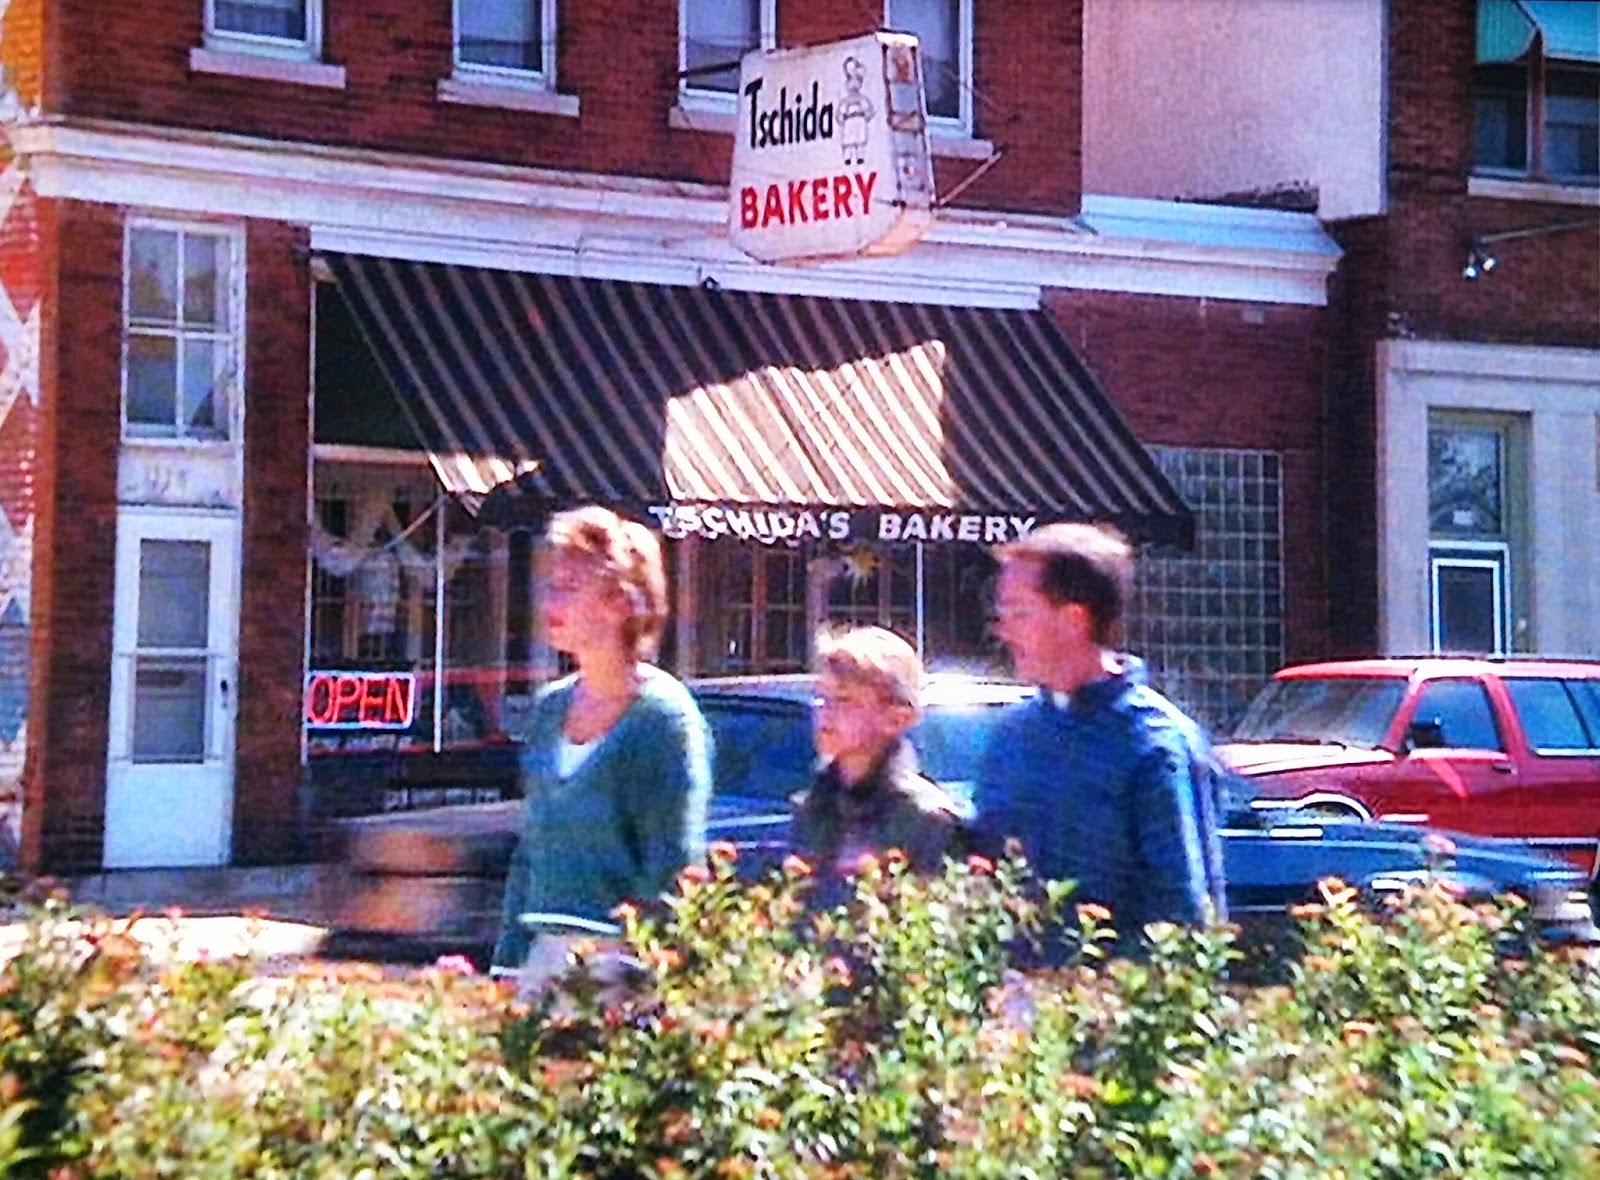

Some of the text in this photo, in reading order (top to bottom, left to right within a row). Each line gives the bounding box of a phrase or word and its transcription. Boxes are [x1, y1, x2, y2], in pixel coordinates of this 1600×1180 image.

[744, 76, 834, 149] Tschida
[740, 171, 878, 230] BAKERY
[647, 504, 1037, 544] TSCHIDA'S BAKERY
[307, 675, 415, 724] OPEN
